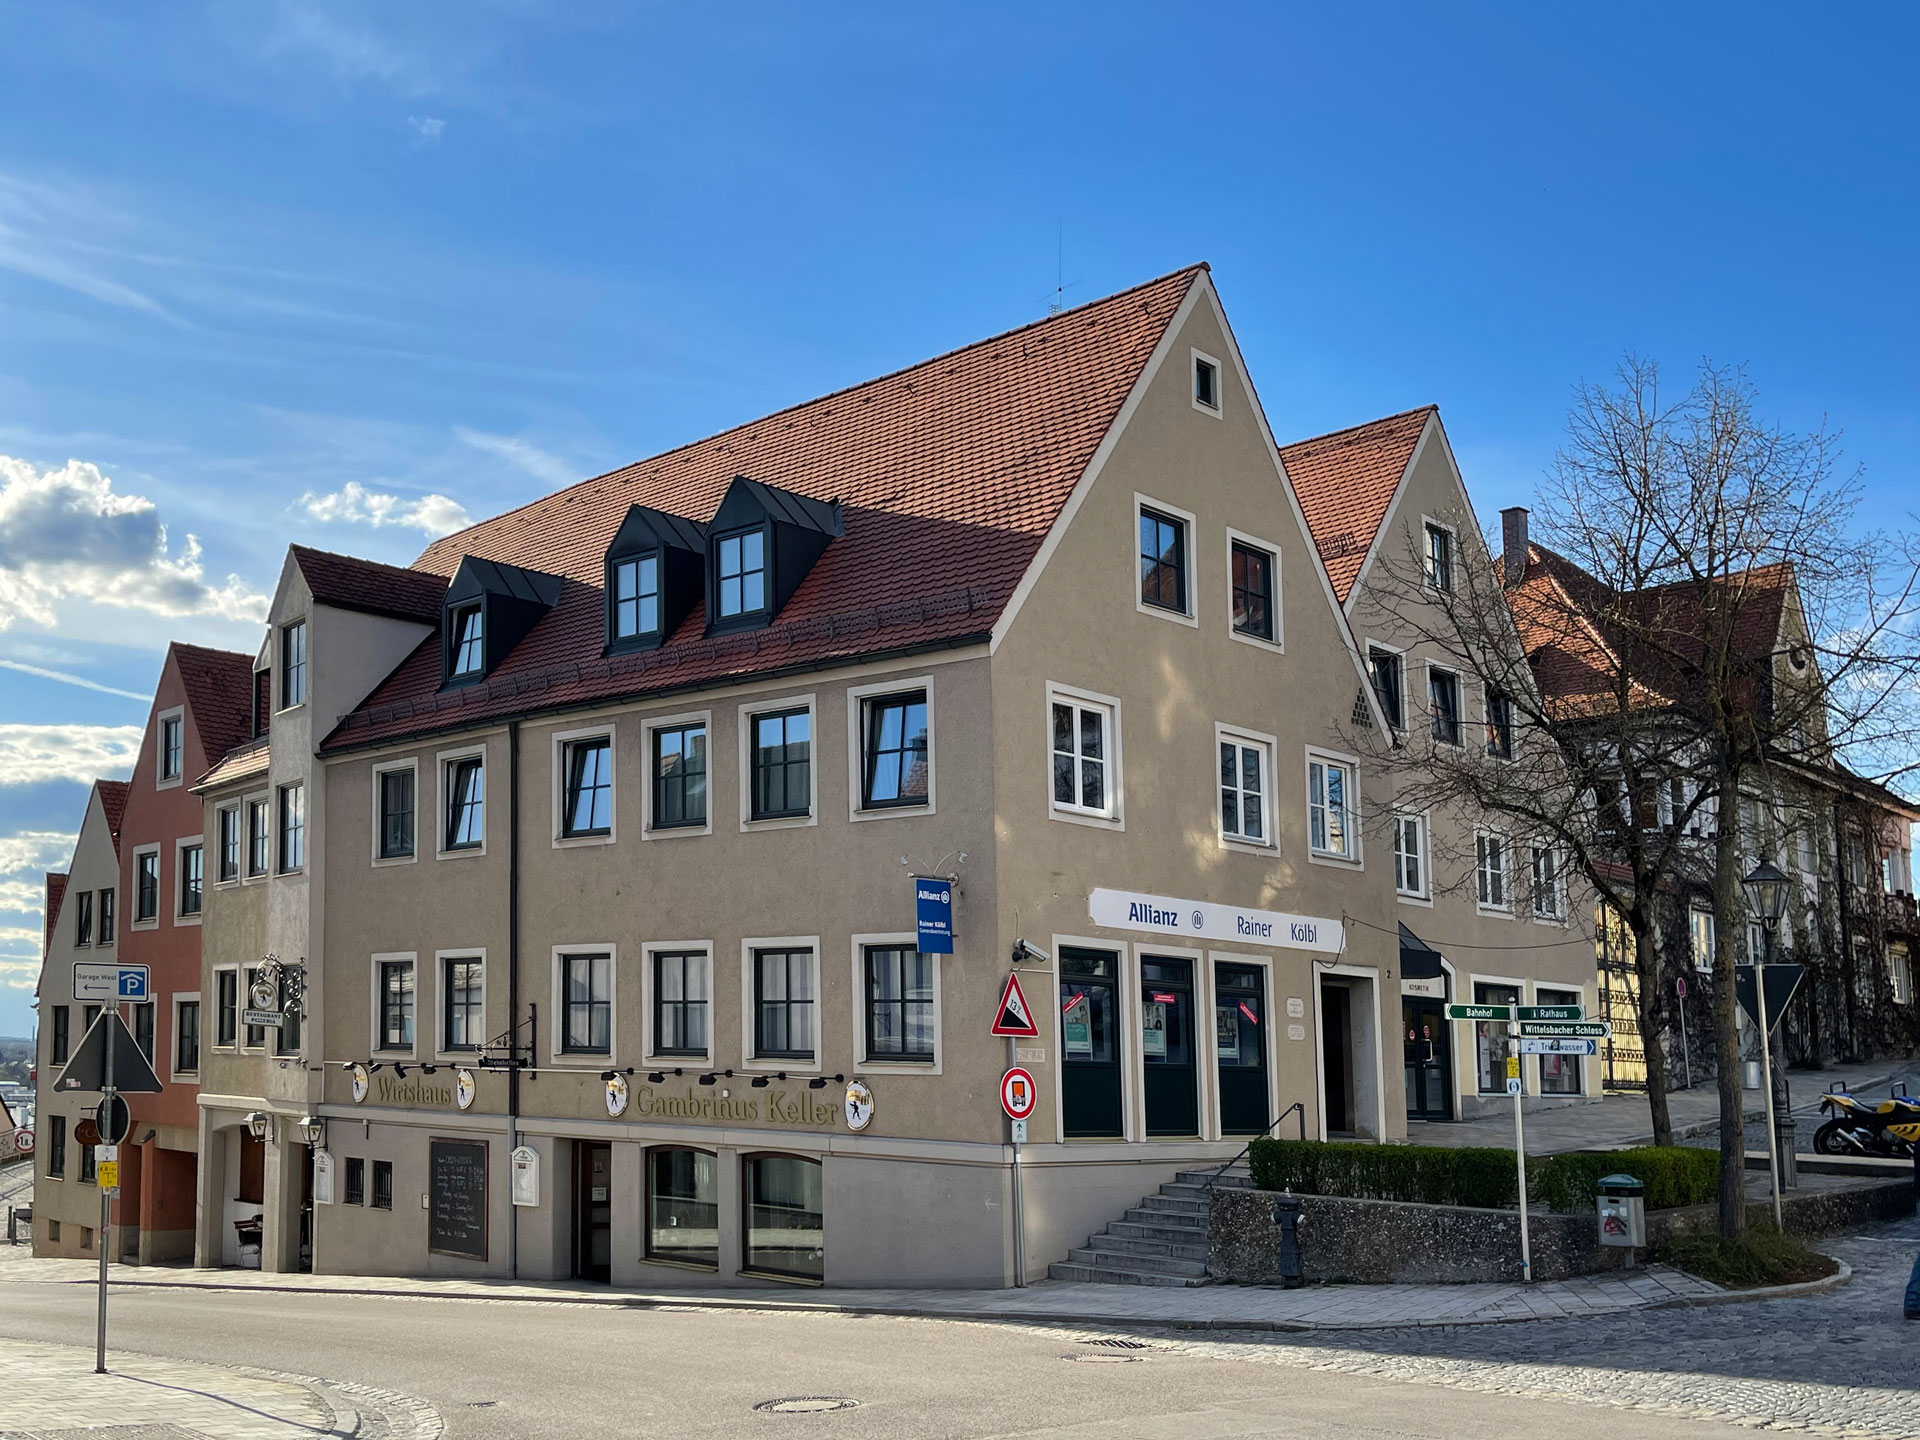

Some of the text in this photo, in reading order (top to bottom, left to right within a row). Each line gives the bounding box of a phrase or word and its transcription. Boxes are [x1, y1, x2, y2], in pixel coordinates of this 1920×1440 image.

[918, 890, 941, 901] Allianz
[919, 920, 934, 928] Rainer
[1128, 902, 1318, 944] Allianz Rainer Kölbl
[1387, 970, 1391, 978] 2
[127, 979, 138, 994] P
[1408, 983, 1430, 992] KOSMETIK
[1009, 999, 1022, 1015] 13%
[1466, 1007, 1493, 1018] Bahnhof
[245, 1011, 282, 1019] RESTAURANT
[1540, 1009, 1568, 1019] Rathaus
[1525, 1024, 1603, 1036] Wittelsbacher Schloss
[1540, 1042, 1584, 1052] Triwasser
[377, 1076, 451, 1105] Wirtshaus
[635, 1086, 839, 1126] Gambrinus Keller
